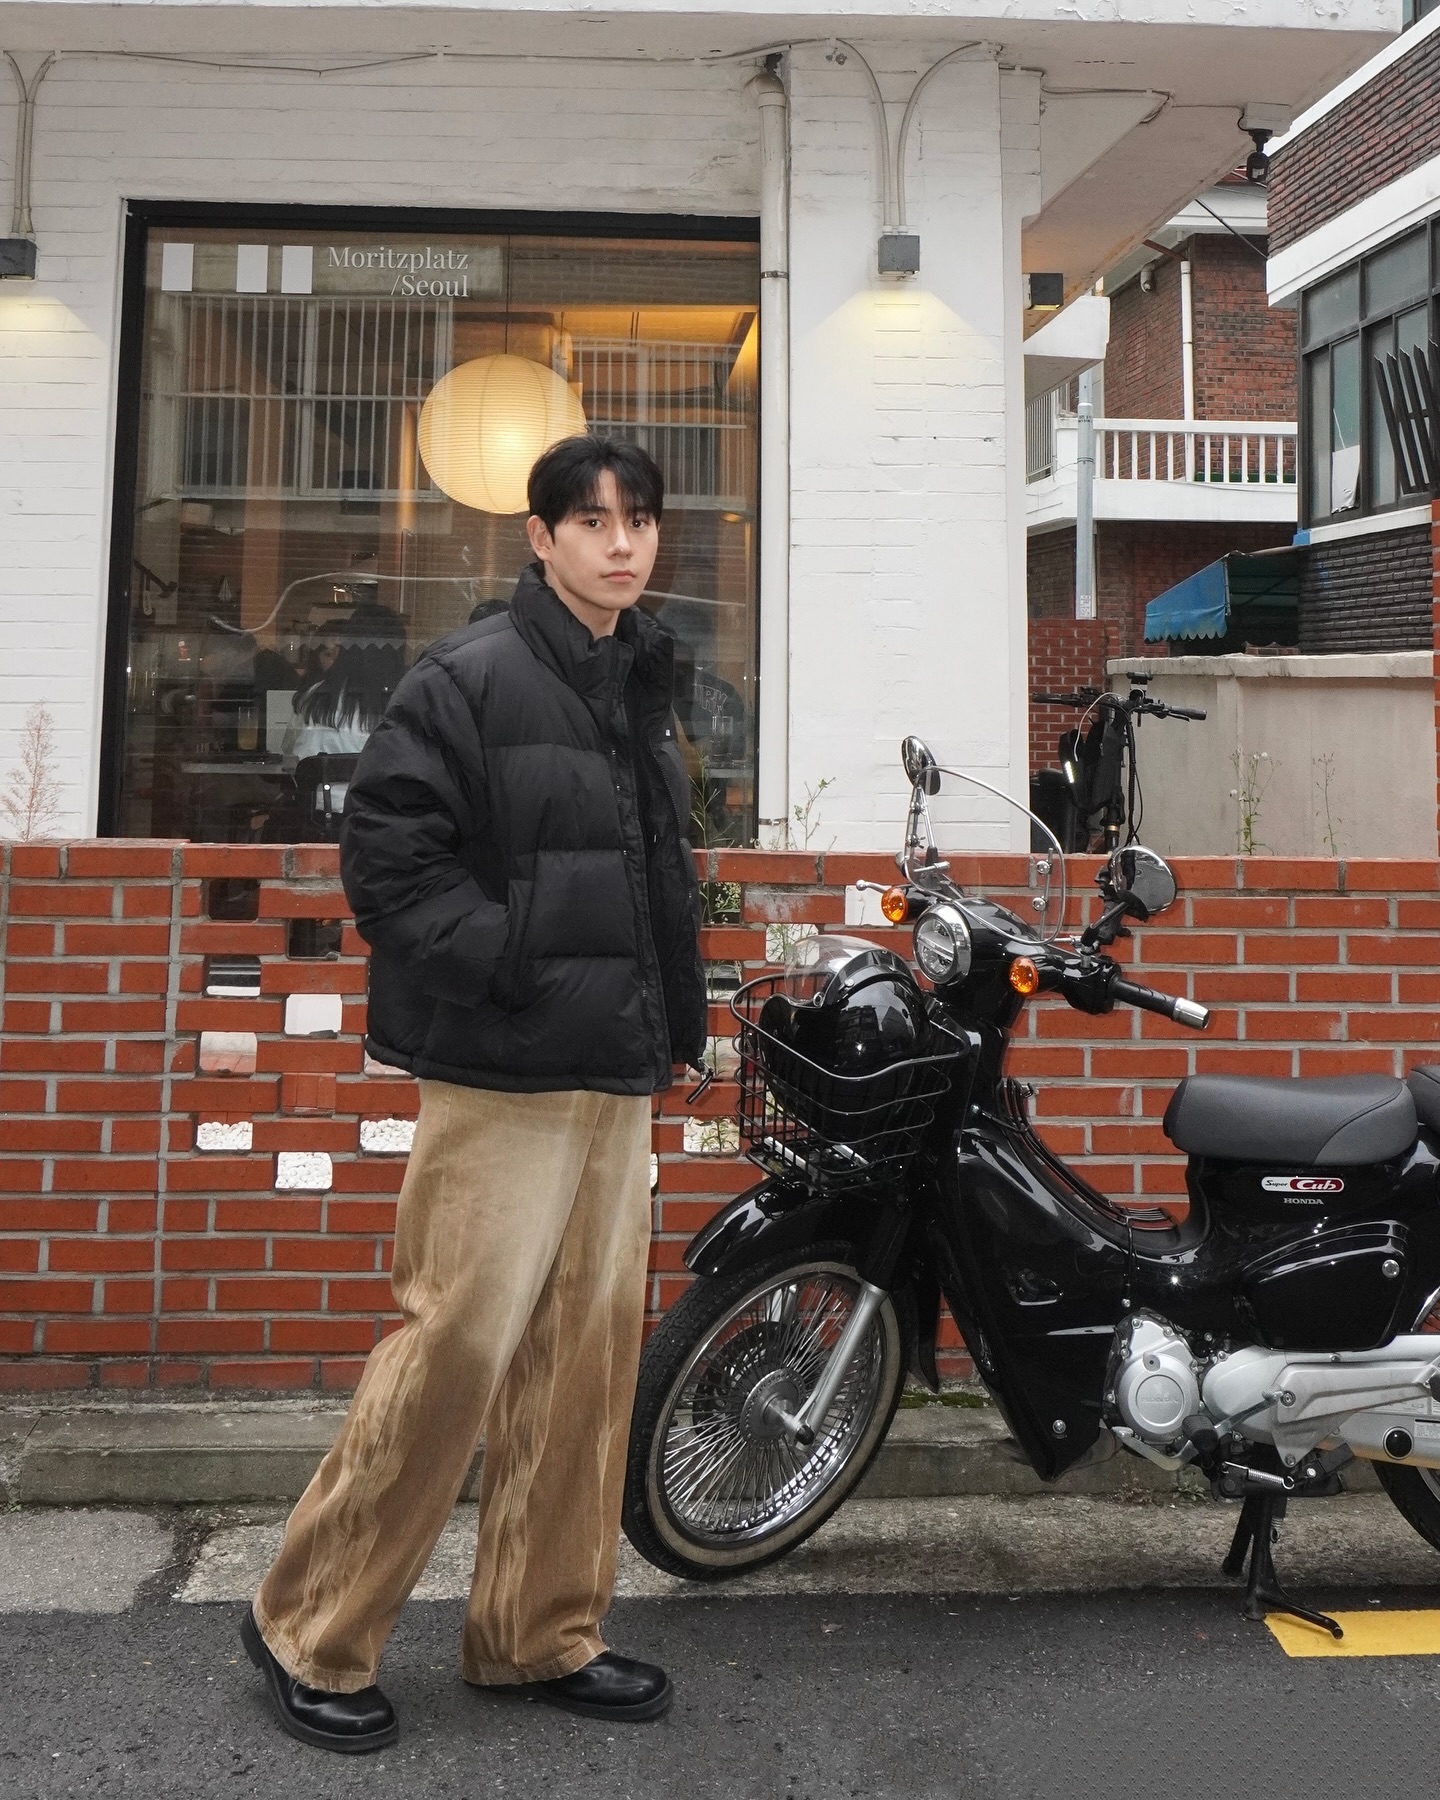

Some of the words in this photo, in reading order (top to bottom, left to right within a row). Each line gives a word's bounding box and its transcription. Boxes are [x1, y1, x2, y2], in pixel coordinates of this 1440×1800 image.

[328, 246, 469, 273] Moritzplatz
[391, 275, 469, 297] /Seoul
[1297, 1179, 1336, 1190] Cub
